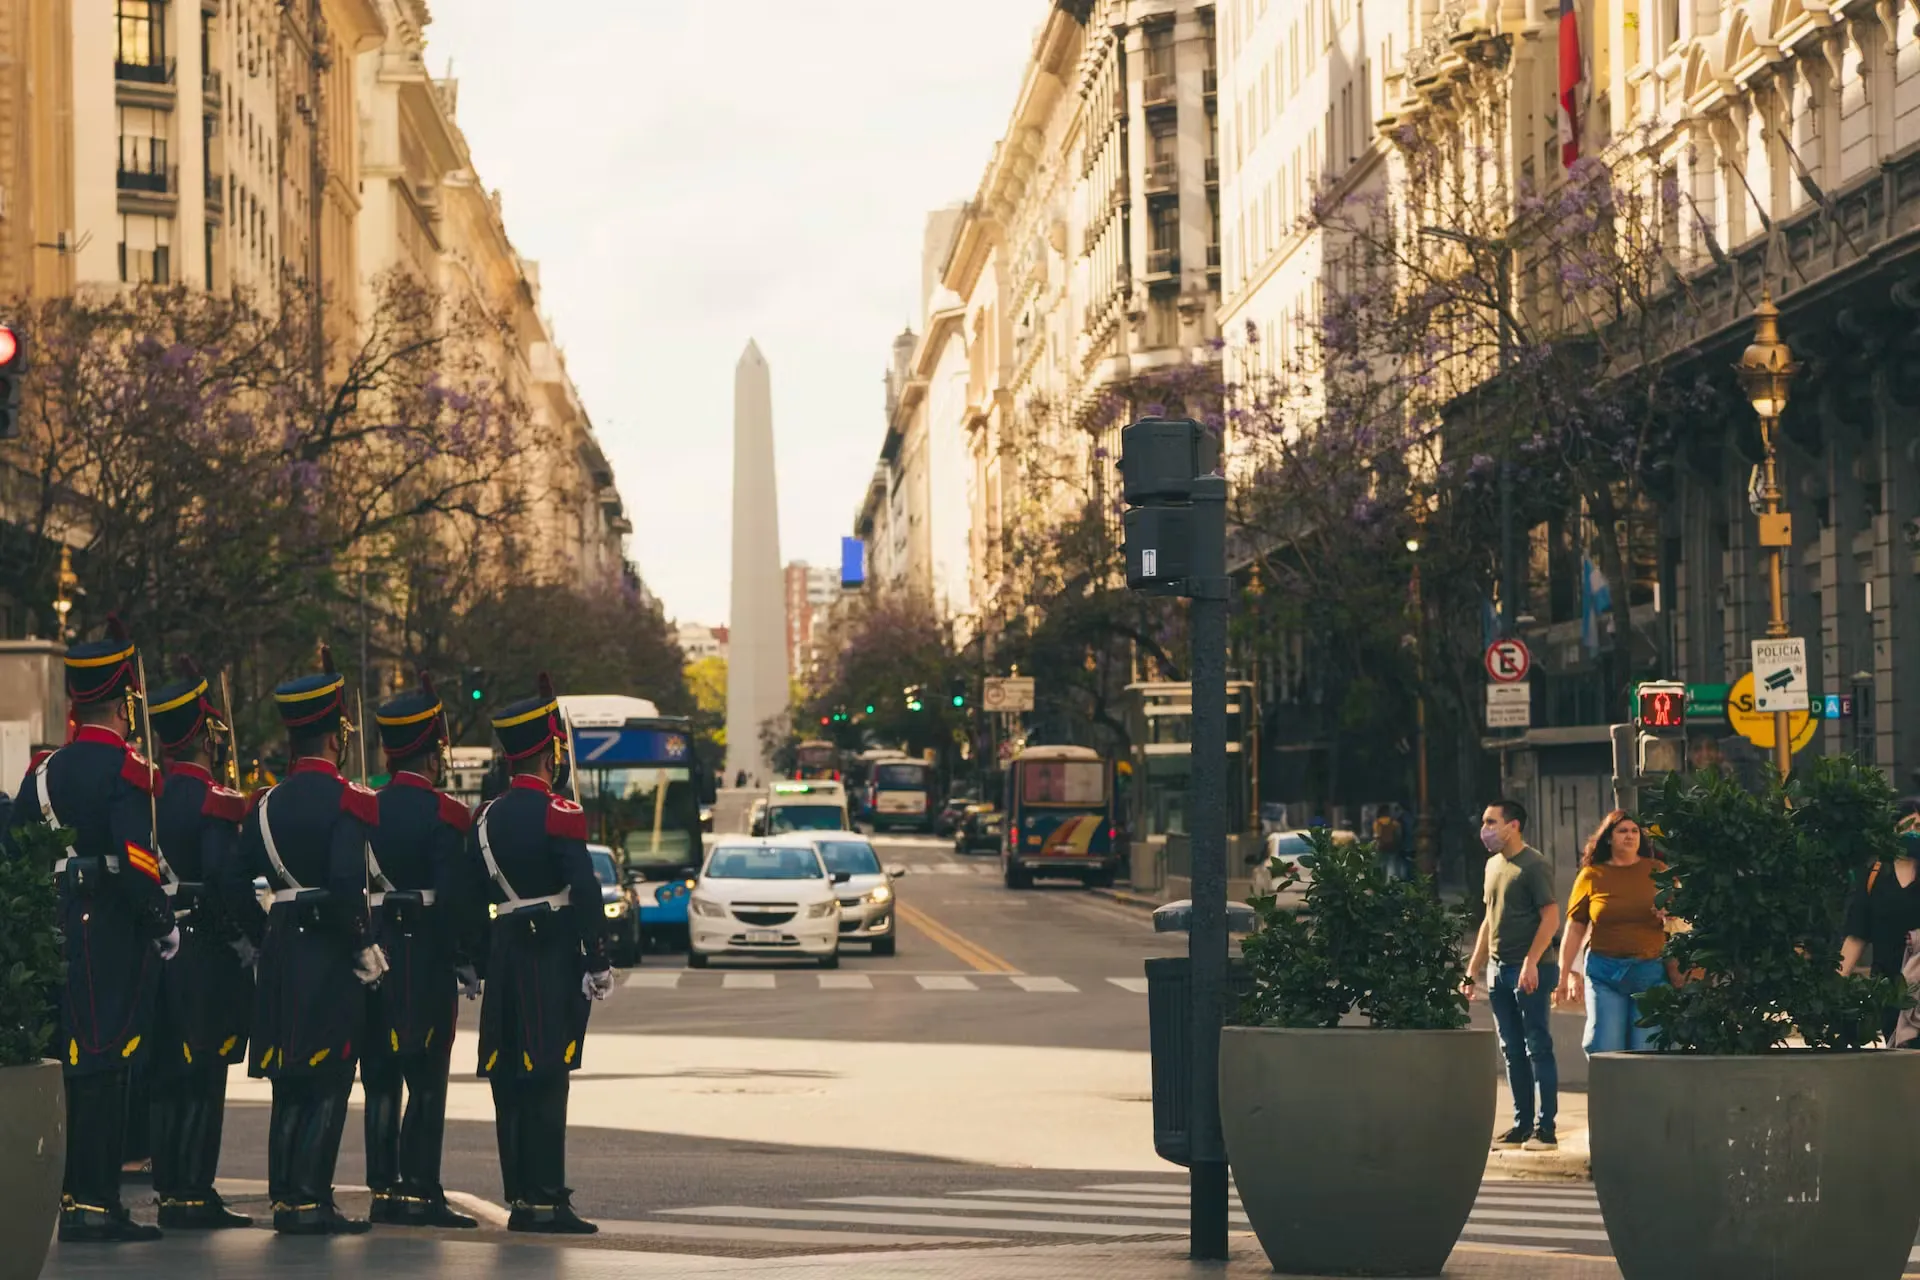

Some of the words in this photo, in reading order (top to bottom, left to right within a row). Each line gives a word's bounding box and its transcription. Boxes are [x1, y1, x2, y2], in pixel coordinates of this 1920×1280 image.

[1500, 648, 1516, 672] E
[1811, 700, 1822, 713] D
[1826, 700, 1838, 713] A
[1843, 701, 1851, 714] E
[578, 730, 621, 760] 7
